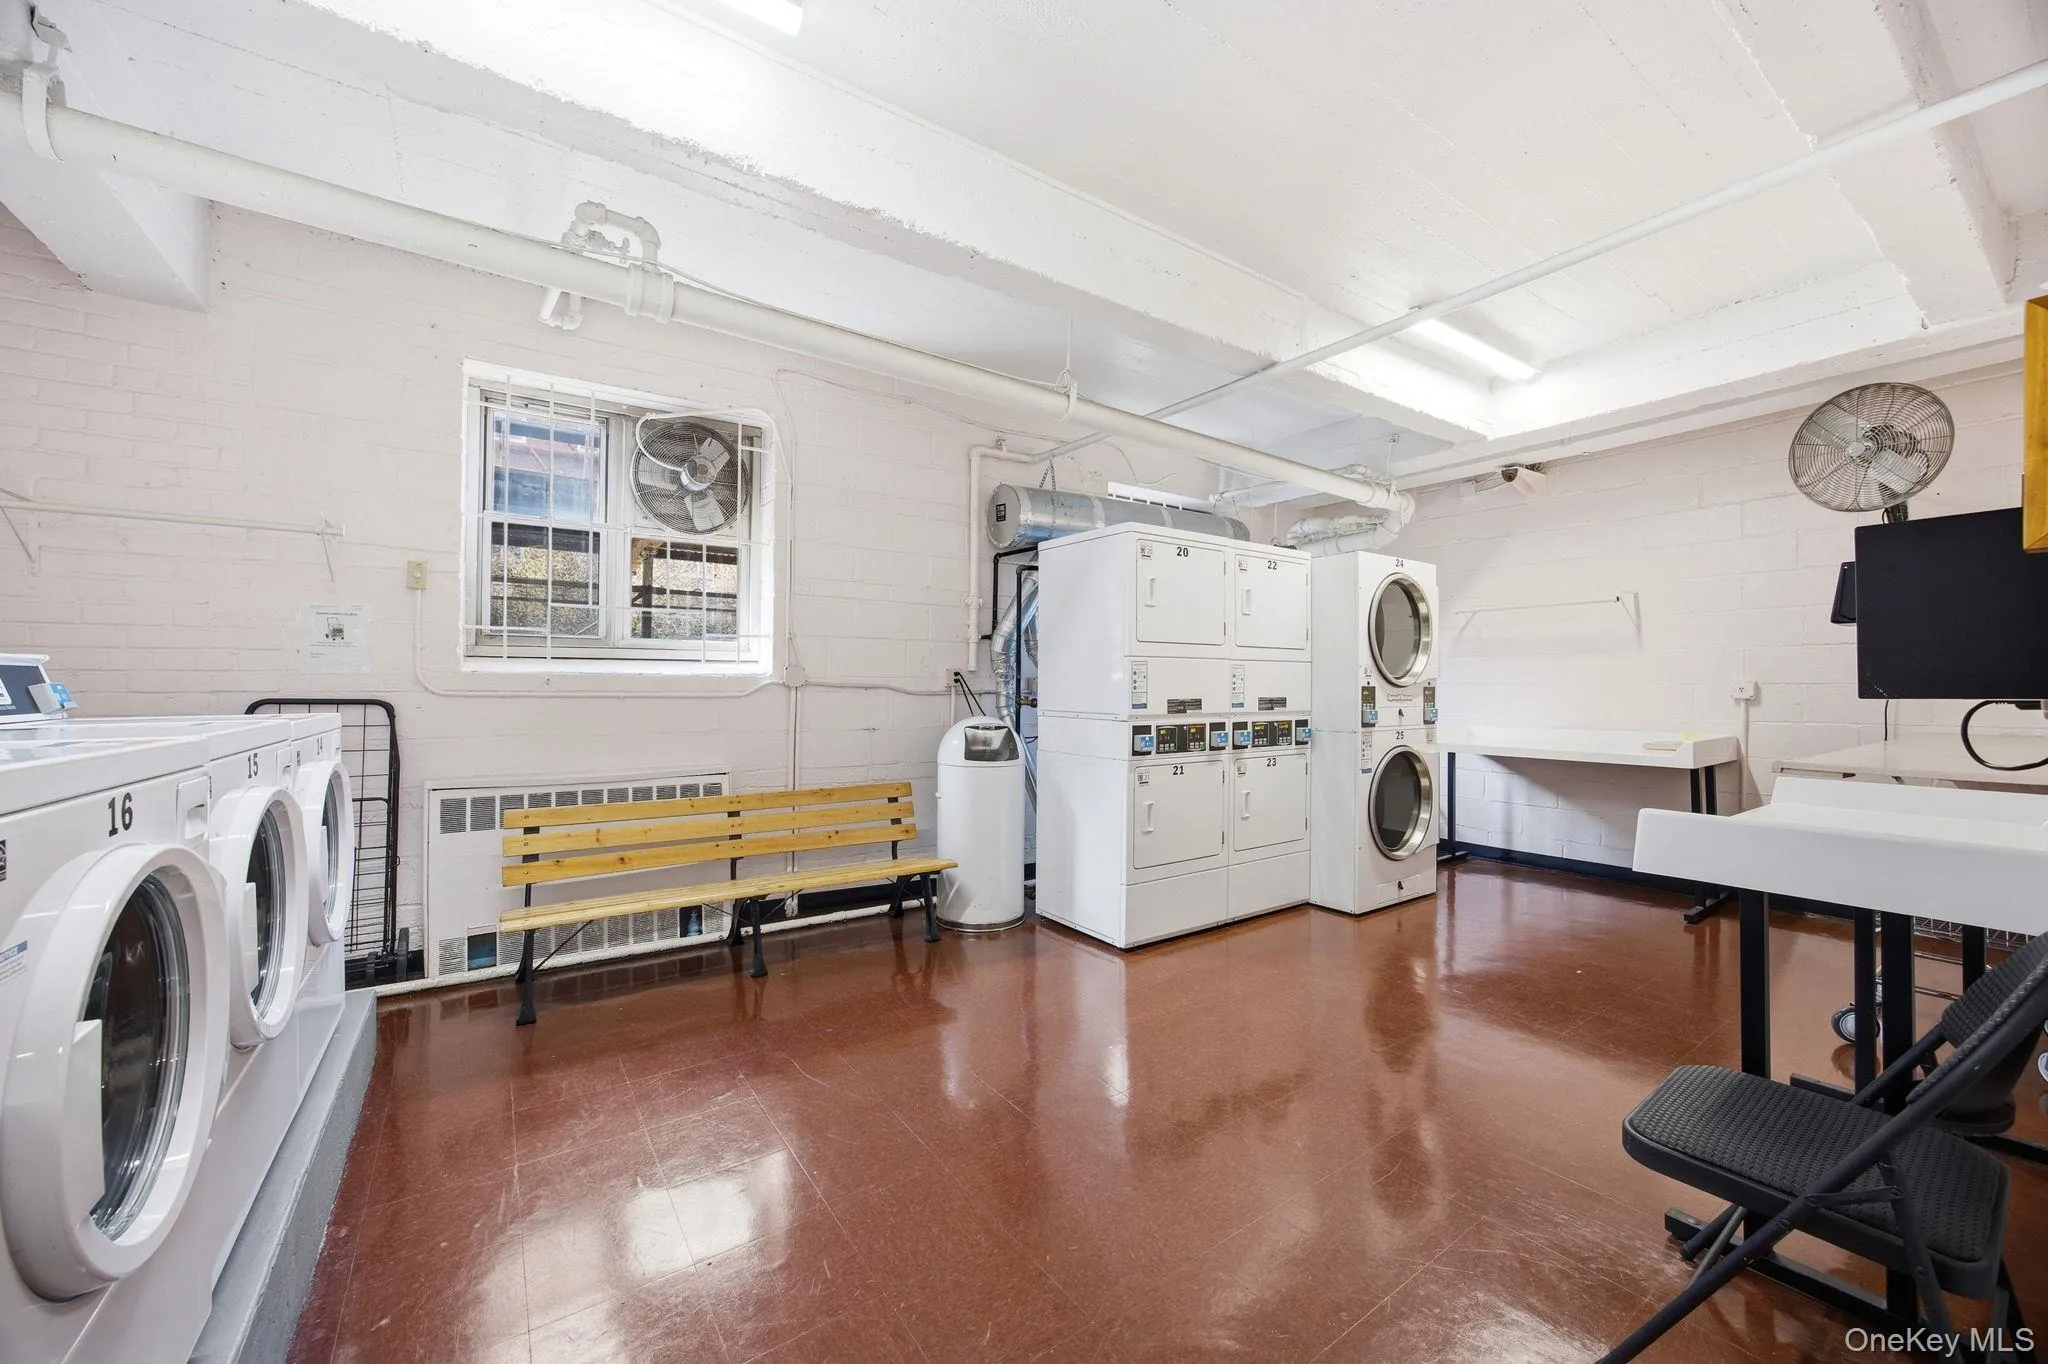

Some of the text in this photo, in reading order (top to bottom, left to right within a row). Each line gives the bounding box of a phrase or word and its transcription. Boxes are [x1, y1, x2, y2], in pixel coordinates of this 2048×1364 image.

[1176, 546, 1189, 558] 20
[1267, 560, 1278, 570] 22
[1395, 558, 1404, 568] 24
[1395, 731, 1404, 740] 25
[247, 752, 259, 779] 15
[1266, 757, 1277, 767] 23
[1172, 765, 1185, 776] 21
[108, 792, 133, 837] 16
